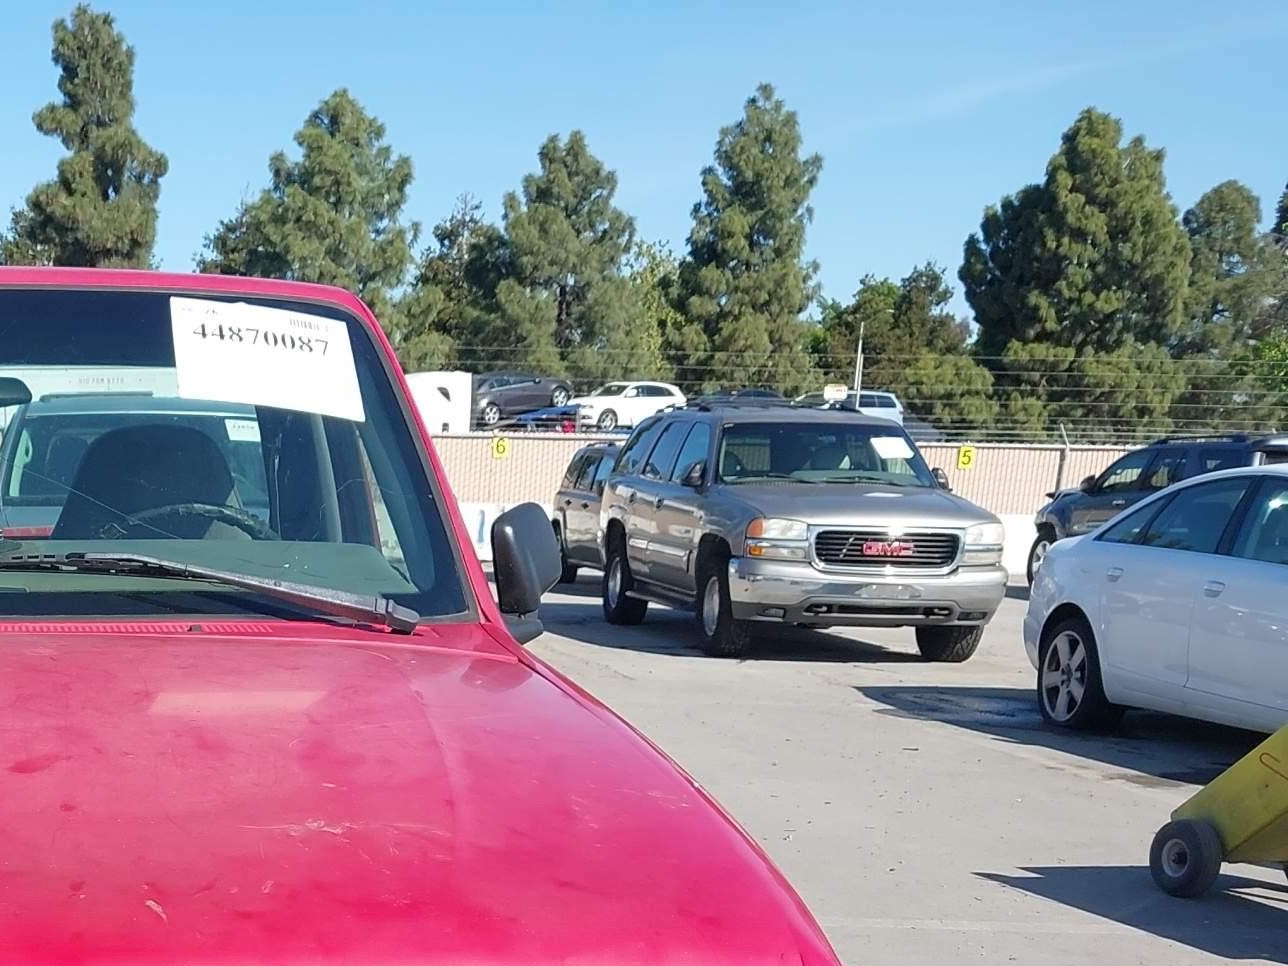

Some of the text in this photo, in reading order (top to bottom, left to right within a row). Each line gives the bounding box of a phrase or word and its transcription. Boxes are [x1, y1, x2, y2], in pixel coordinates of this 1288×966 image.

[193, 323, 329, 356] 44870087
[496, 437, 506, 454] 6
[961, 449, 972, 465] 5
[862, 541, 914, 556] GMC
